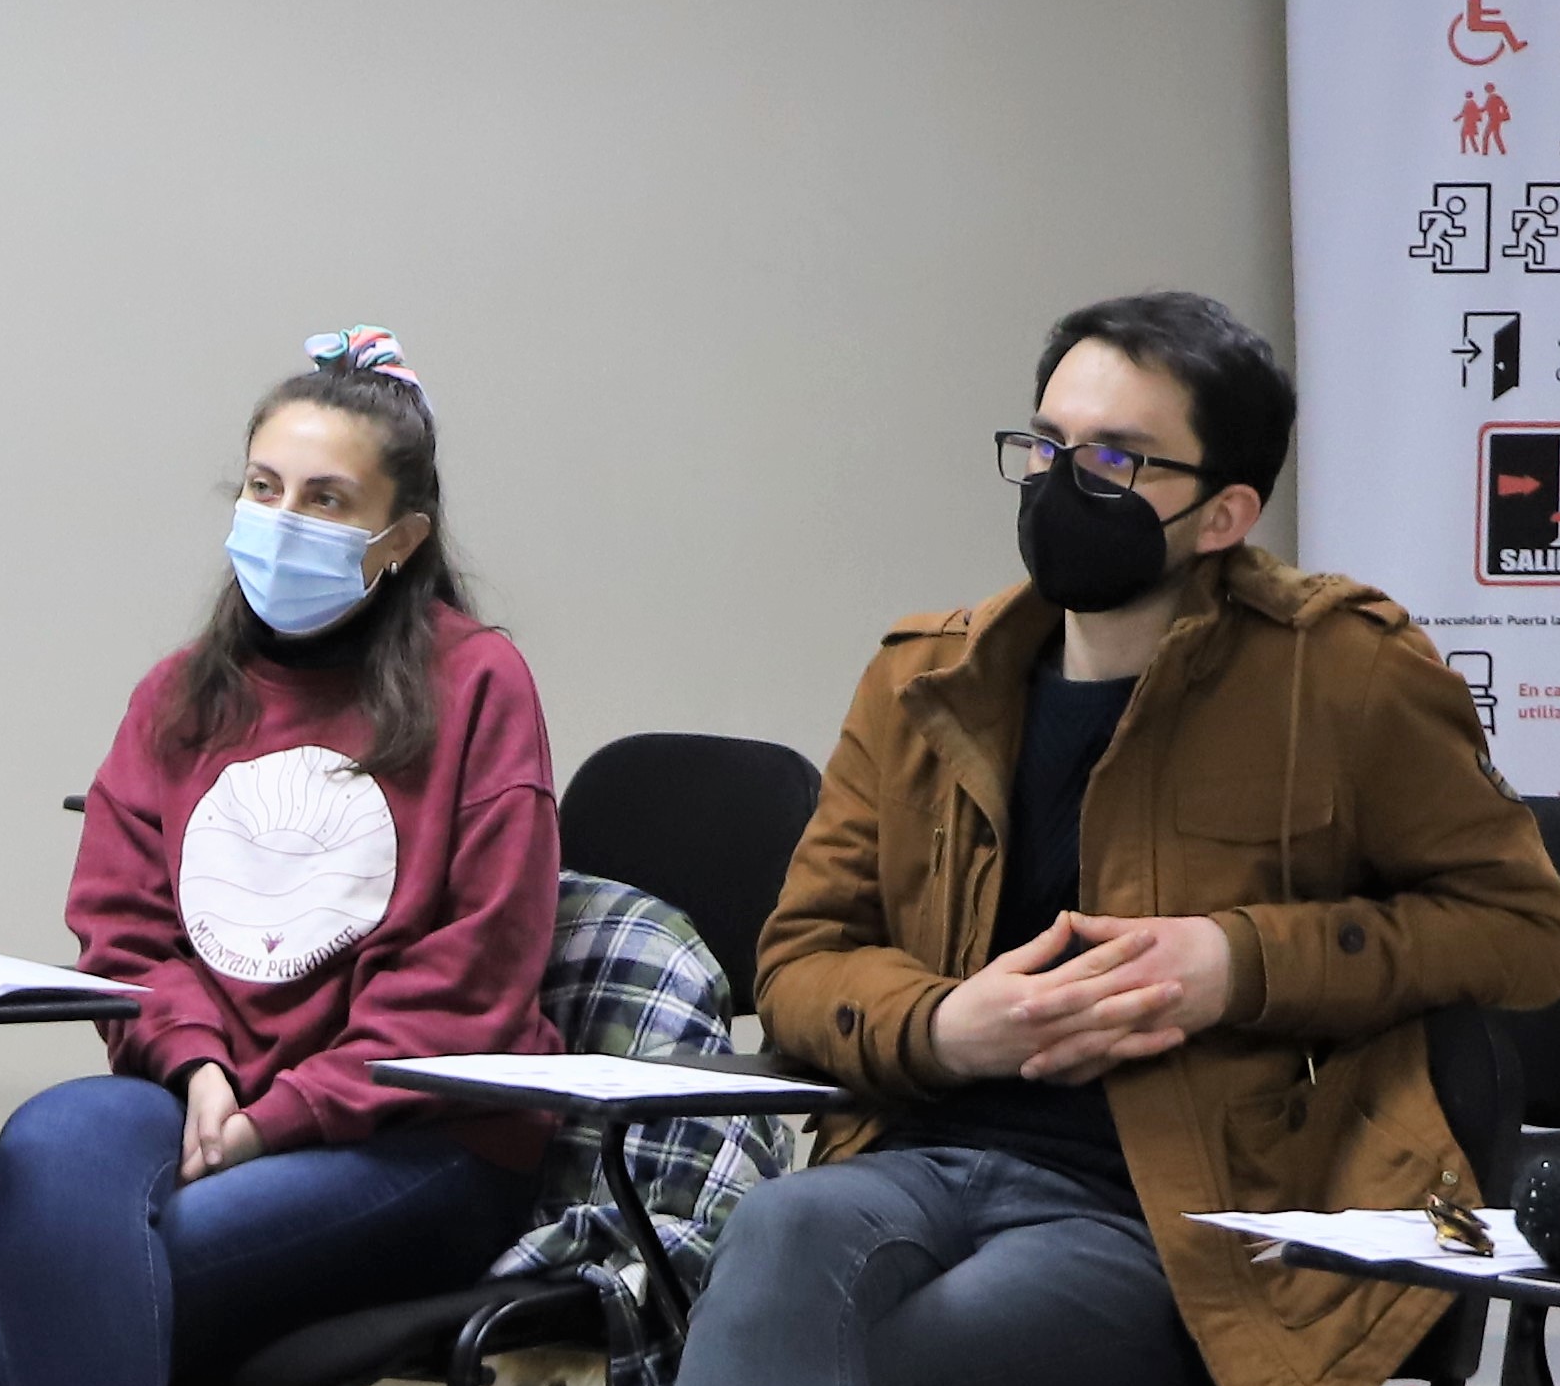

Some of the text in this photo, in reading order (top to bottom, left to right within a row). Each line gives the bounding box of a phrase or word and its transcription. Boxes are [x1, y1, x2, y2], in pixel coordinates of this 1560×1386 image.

[1518, 683, 1540, 698] En
[189, 919, 362, 978] MOUNTAIN PARADISE
